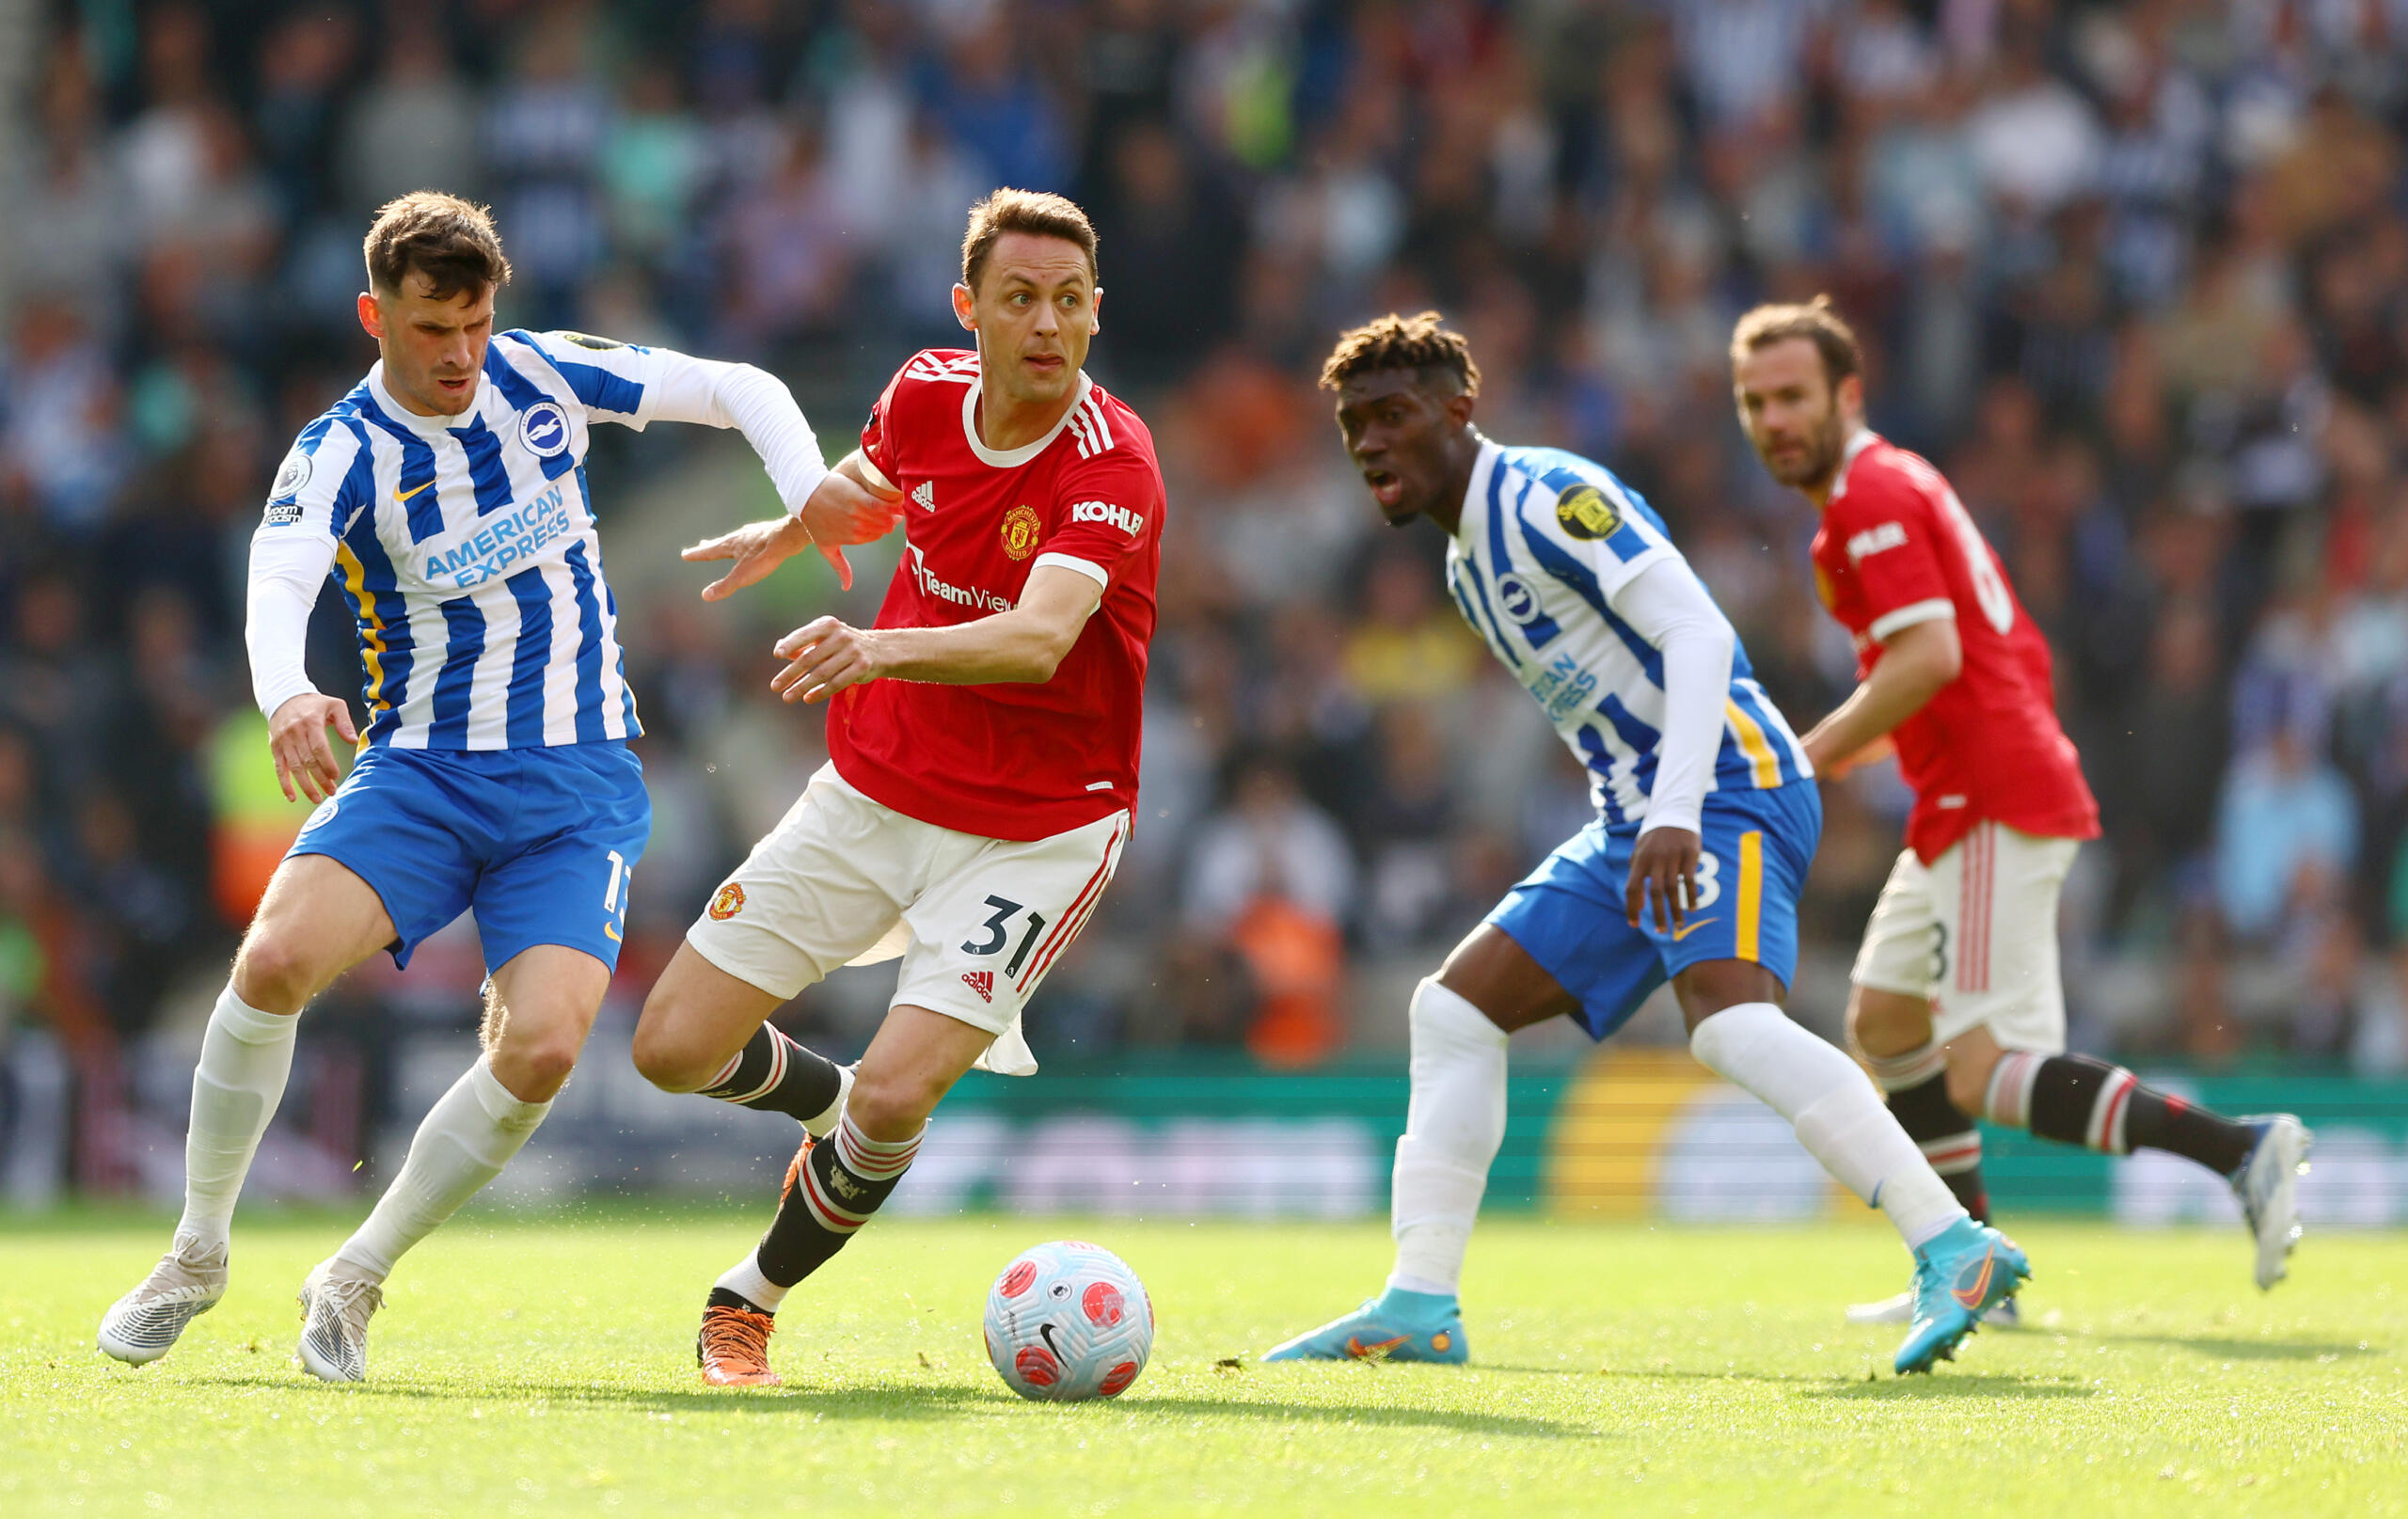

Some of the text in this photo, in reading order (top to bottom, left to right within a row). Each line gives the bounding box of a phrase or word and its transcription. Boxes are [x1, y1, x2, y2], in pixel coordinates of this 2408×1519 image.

[425, 484, 562, 580] AMERICAN
[911, 490, 936, 514] adidas
[454, 509, 570, 589] EXPRESS
[960, 894, 1047, 979] 31
[961, 973, 992, 1004] adidas
